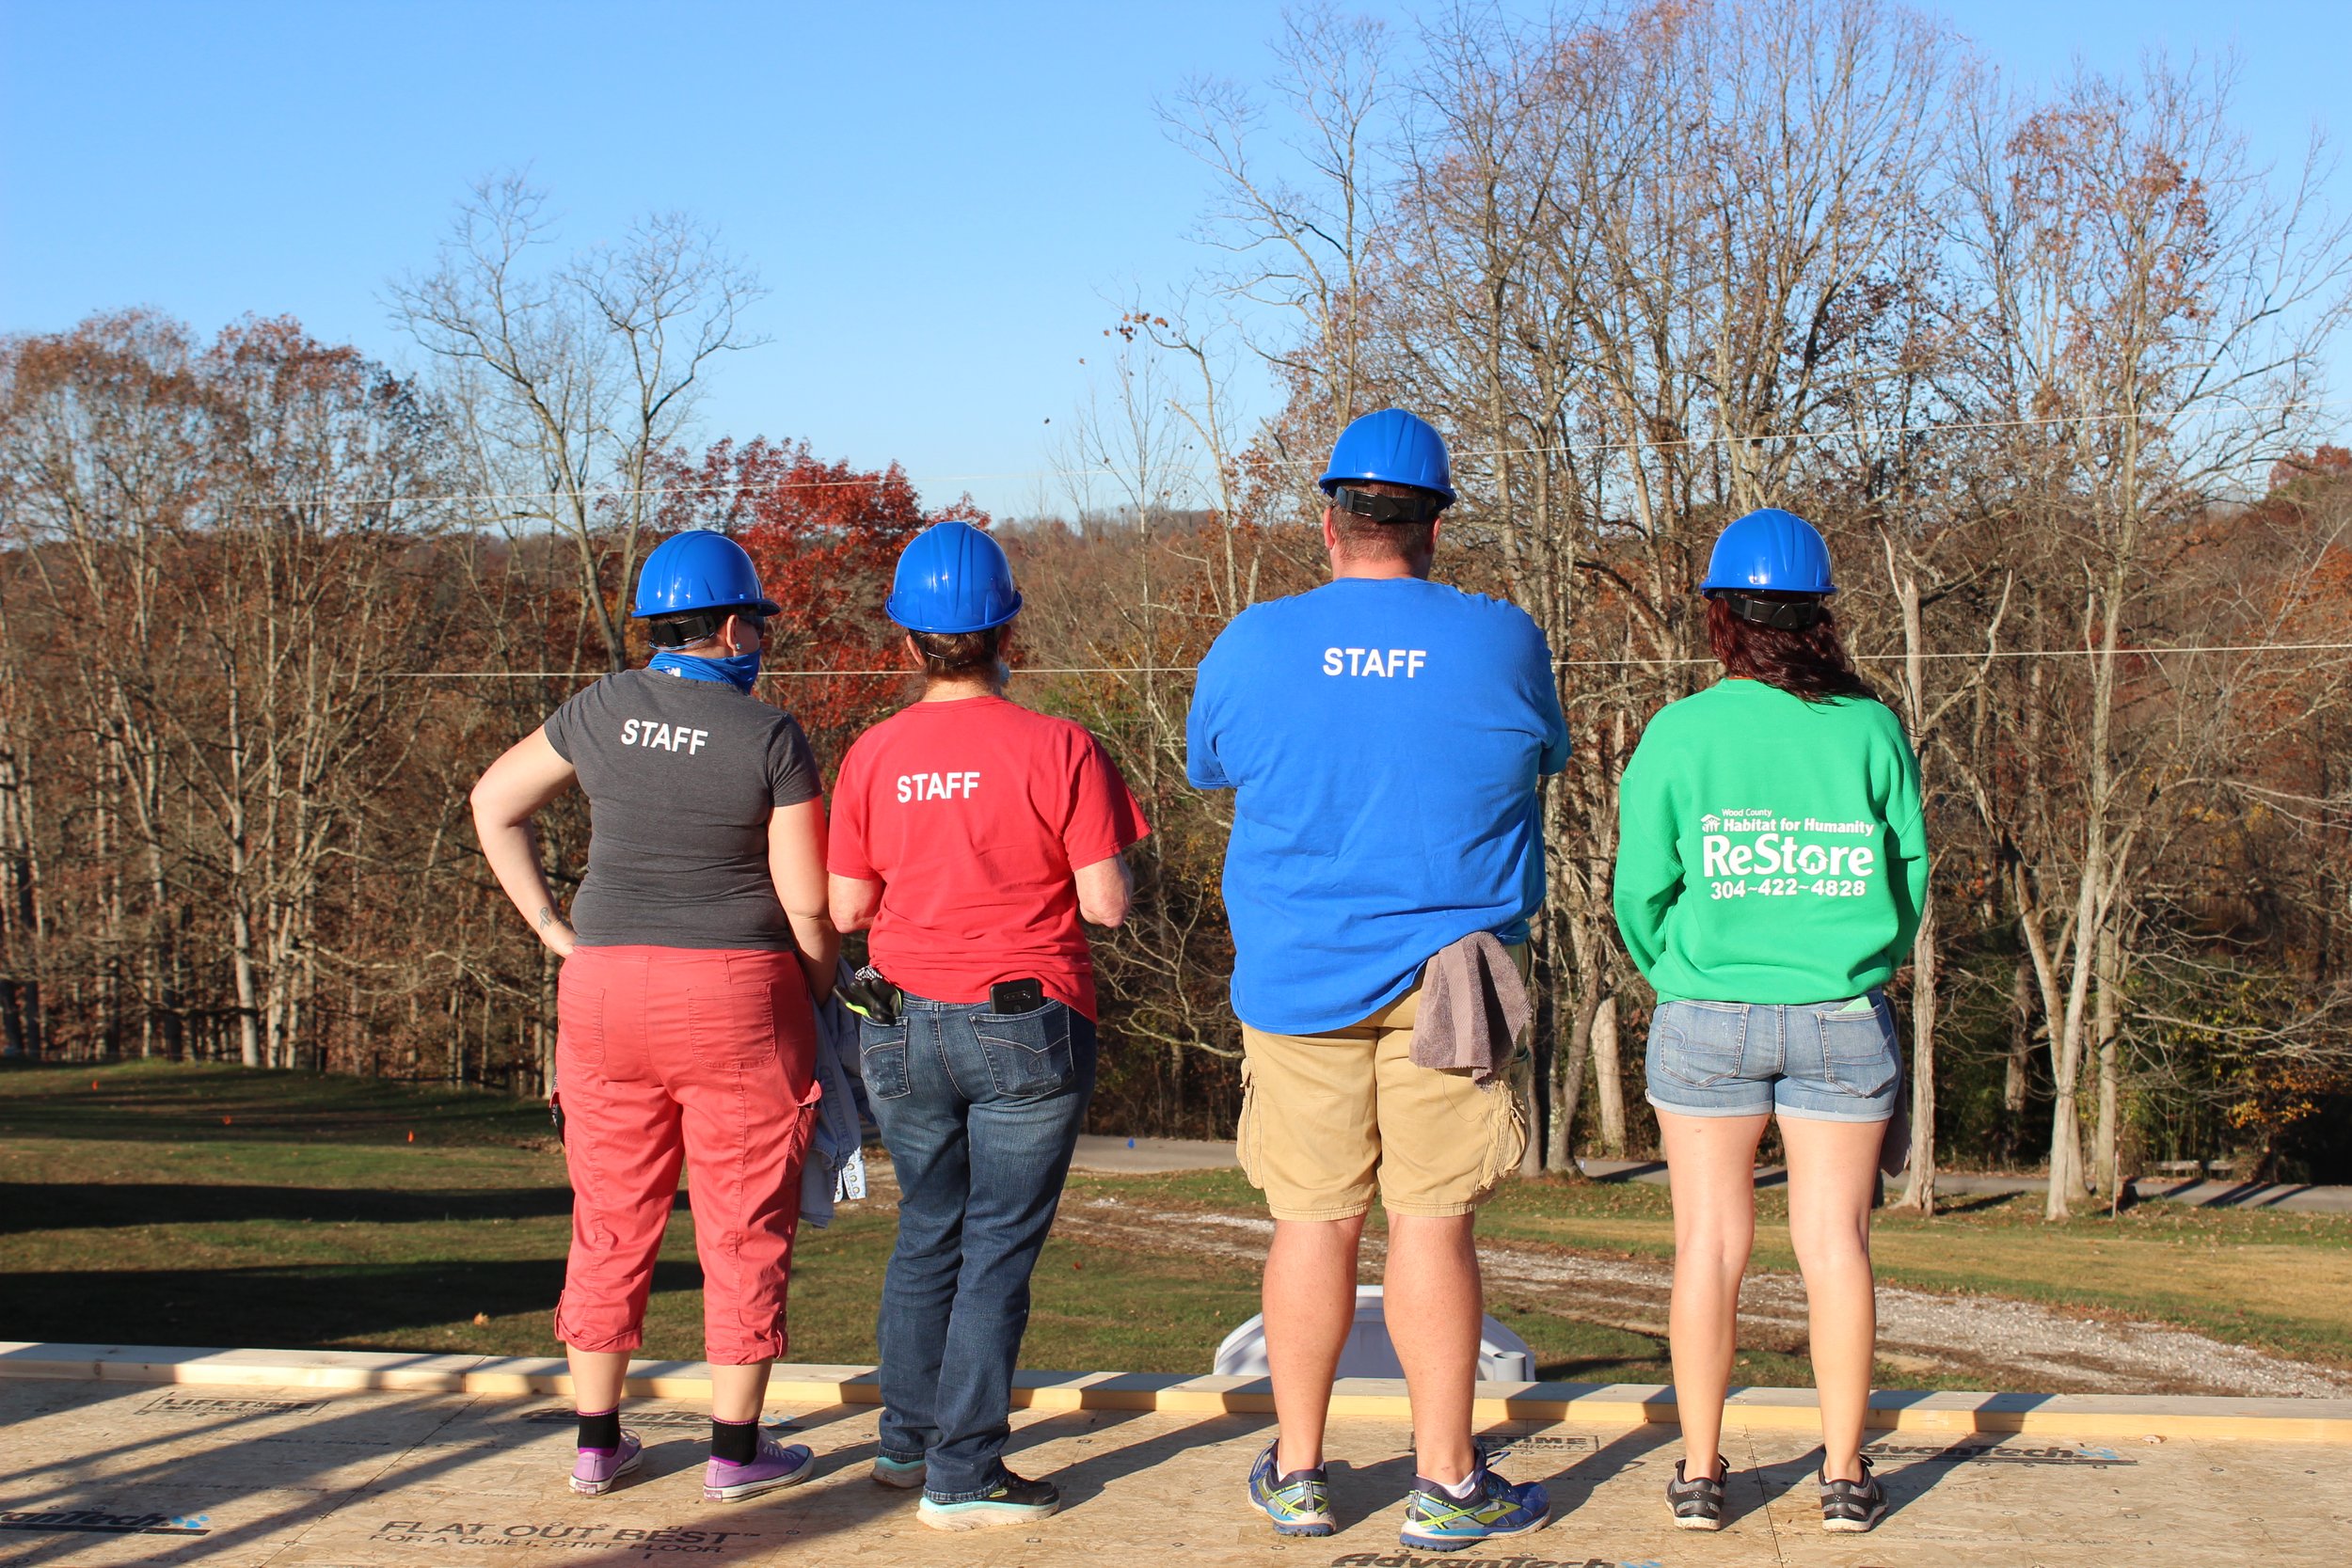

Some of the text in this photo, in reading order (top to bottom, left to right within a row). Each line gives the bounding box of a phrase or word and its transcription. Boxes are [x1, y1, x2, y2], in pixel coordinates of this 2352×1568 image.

[1323, 647, 1426, 678] STAFF
[620, 719, 708, 754] STAFF
[897, 771, 980, 802] STAFF
[1722, 808, 1772, 817] Wood County
[1724, 817, 1874, 836] Habitat for Humanity
[1703, 833, 1874, 877] ReStore
[1859, 1443, 2074, 1458] dvanTech
[378, 1520, 496, 1535] FLAT
[502, 1524, 605, 1539] OUT
[369, 1534, 424, 1543] FOR
[549, 1540, 622, 1549] STIFF
